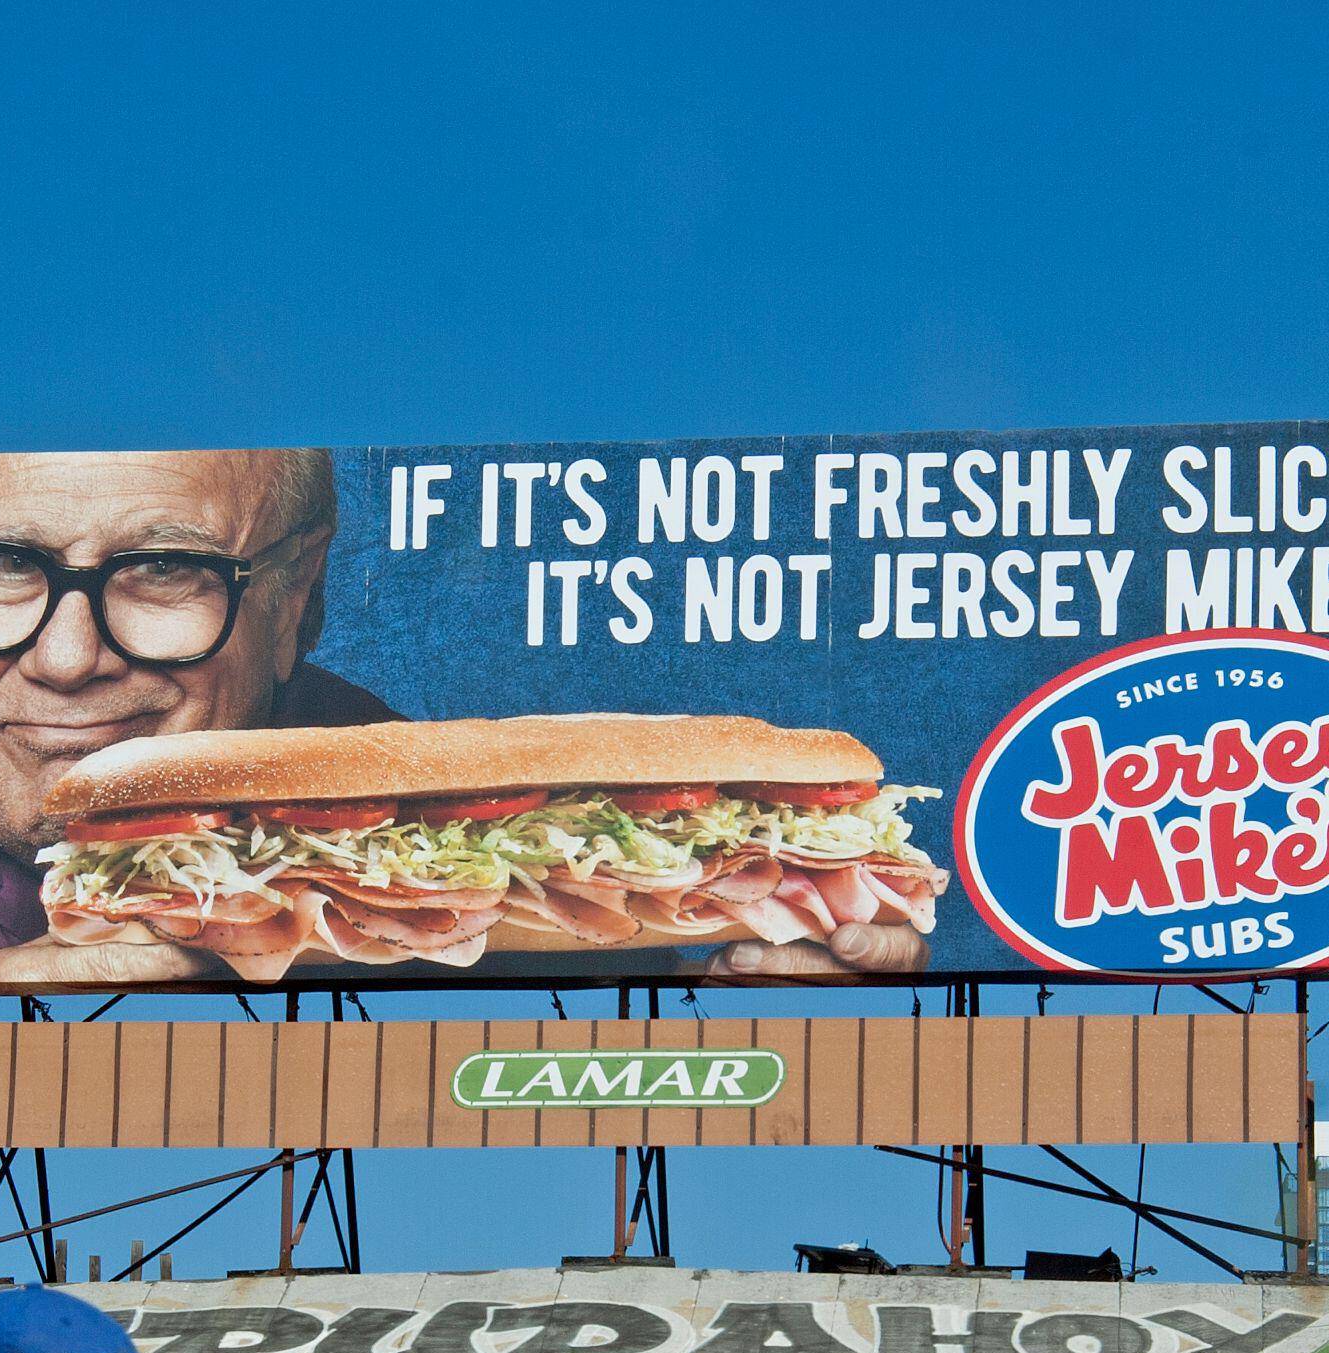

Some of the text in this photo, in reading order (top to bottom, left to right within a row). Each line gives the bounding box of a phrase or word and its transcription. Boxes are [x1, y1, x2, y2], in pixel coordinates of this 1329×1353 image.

[389, 464, 452, 550] IF
[481, 458, 608, 547] IT'S
[637, 454, 784, 543] NOT
[814, 448, 1132, 539] FRESHLY
[526, 556, 653, 646] IT'S
[684, 554, 832, 642] NOT
[858, 549, 1135, 640] JERSEY
[1115, 669, 1284, 709] SINCE 1956
[1159, 911, 1295, 964] SUBS
[480, 1060, 749, 1097] LAMAR
